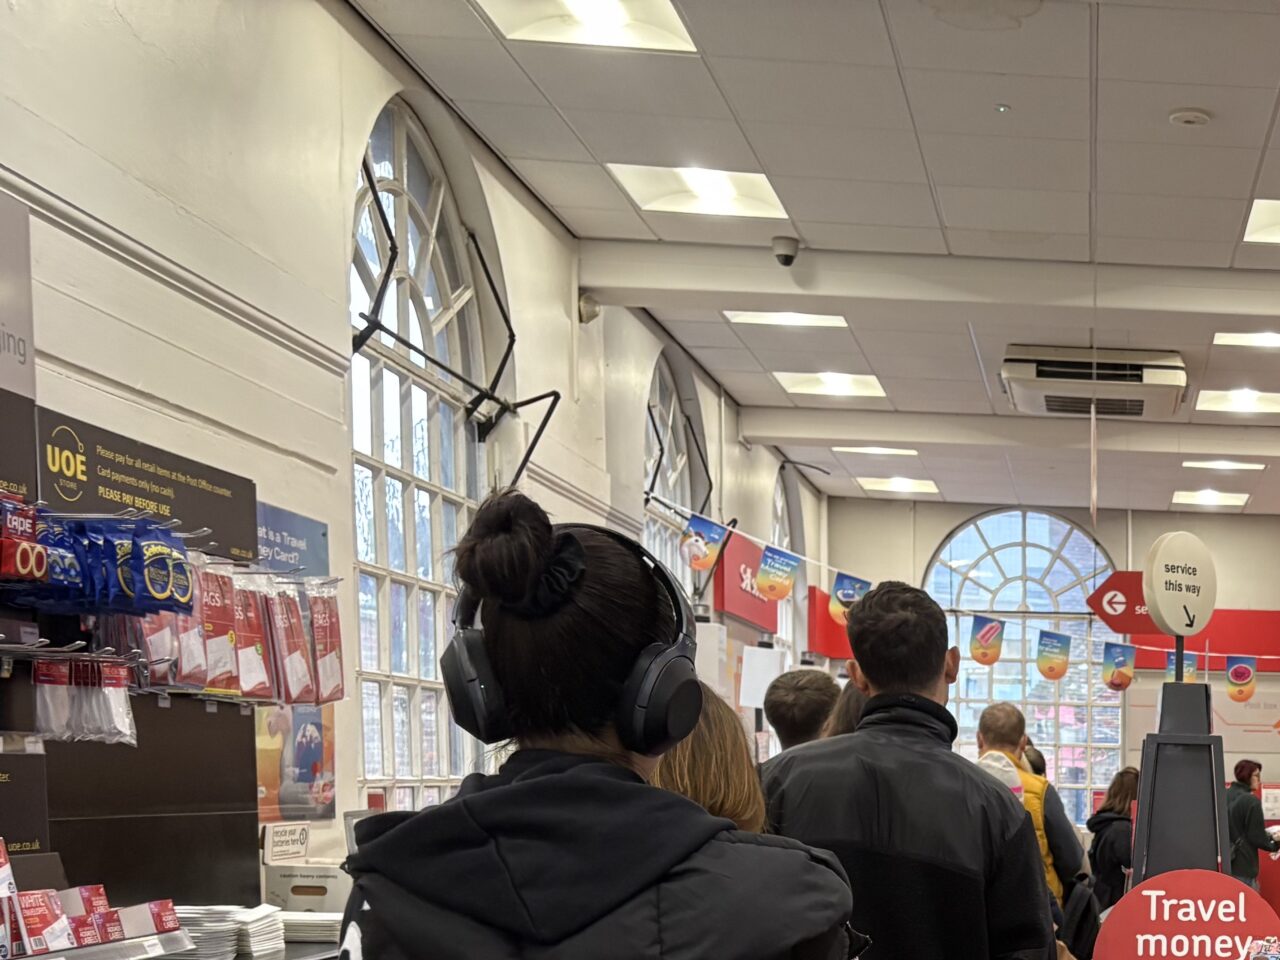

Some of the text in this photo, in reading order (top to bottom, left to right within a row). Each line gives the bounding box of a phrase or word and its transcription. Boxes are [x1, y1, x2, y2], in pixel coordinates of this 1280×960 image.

[0, 322, 26, 366] ing
[46, 444, 88, 482] UOE
[96, 445, 115, 460] Please
[115, 453, 125, 465] pay
[125, 454, 134, 466] for
[134, 459, 142, 469] all
[142, 462, 156, 473] retail
[156, 464, 171, 478] items
[177, 472, 186, 483] the
[186, 475, 198, 487] Post
[198, 479, 213, 491] Office
[59, 479, 78, 491] STORE
[97, 465, 111, 478] Card
[111, 471, 138, 487] payments
[138, 480, 150, 493] only
[97, 485, 171, 517] PLEASE PAY BEFORE USE
[7, 512, 33, 534] tape
[282, 532, 307, 550] Travel
[258, 545, 300, 564] ney Card?
[1164, 563, 1197, 576] service
[1165, 580, 1201, 597] this way
[202, 591, 221, 607] AGS
[1135, 605, 1148, 615] se
[7, 840, 41, 851] uoe.co.uk
[18, 894, 46, 909] WHITE
[1141, 890, 1246, 922] Travel
